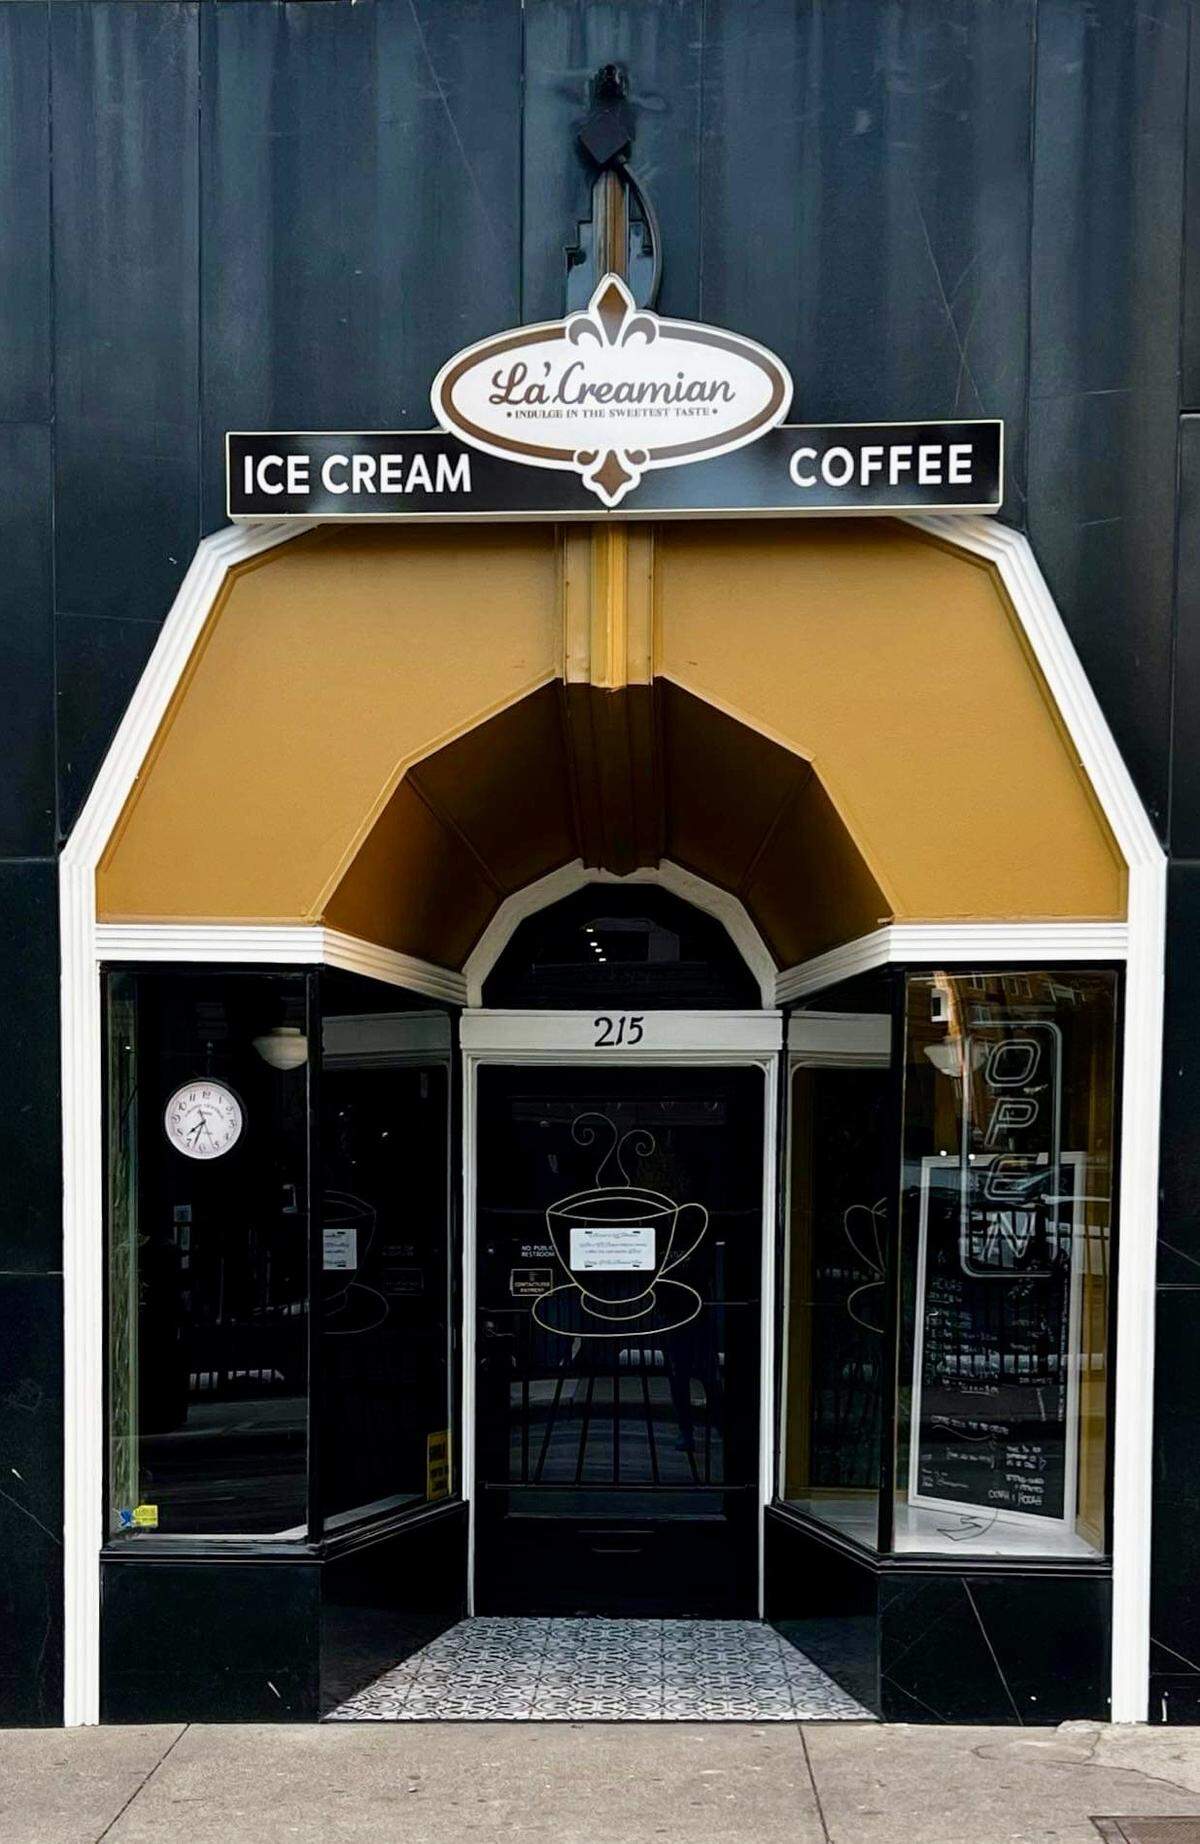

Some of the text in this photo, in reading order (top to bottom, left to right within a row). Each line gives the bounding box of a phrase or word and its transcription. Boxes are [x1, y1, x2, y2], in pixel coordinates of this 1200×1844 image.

[514, 407, 710, 419] INDULGE IN THE SWEETEST TASTE
[244, 453, 473, 495] ICE CREAM
[789, 443, 974, 488] COFFEE
[594, 1016, 644, 1047] 215
[981, 1039, 1042, 1258] OPEN
